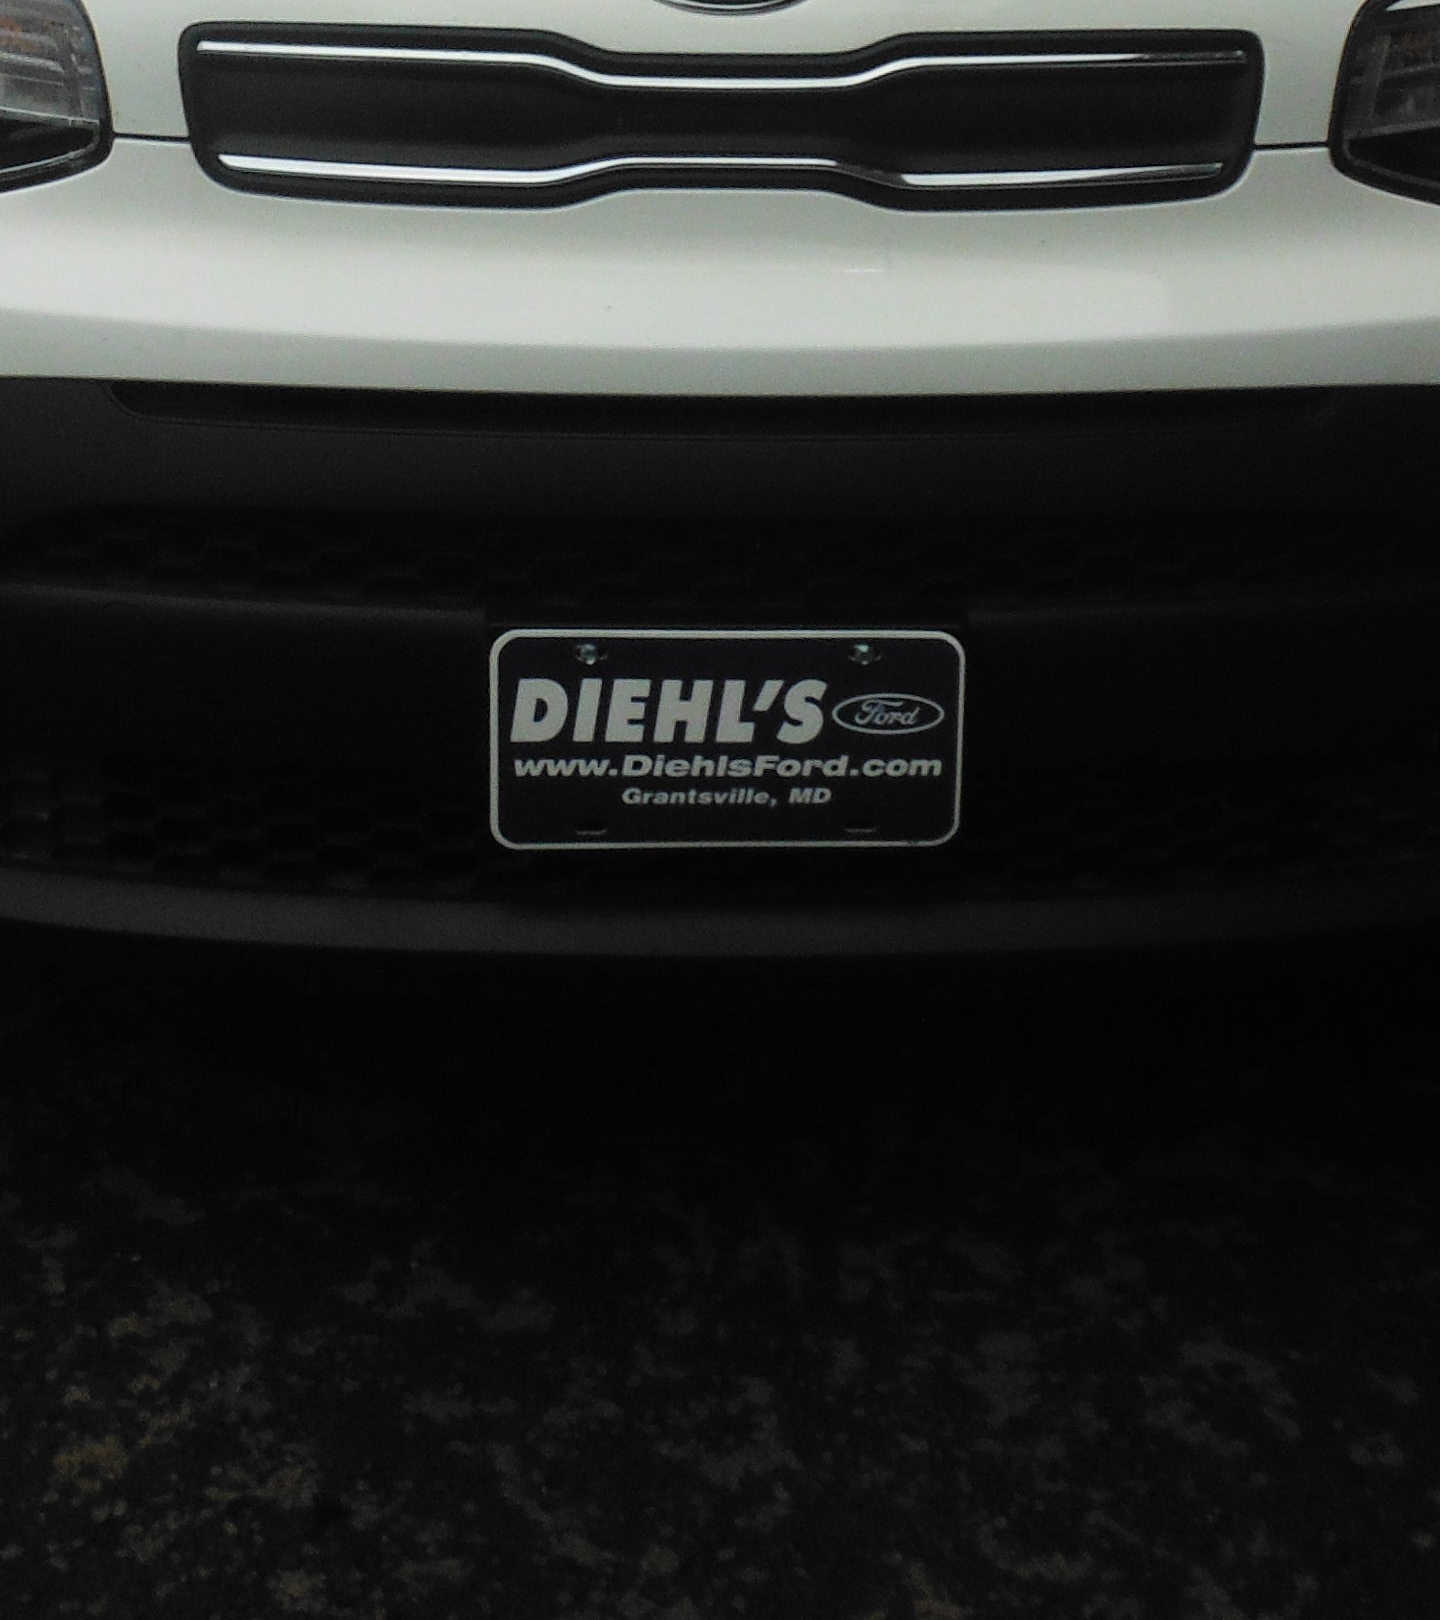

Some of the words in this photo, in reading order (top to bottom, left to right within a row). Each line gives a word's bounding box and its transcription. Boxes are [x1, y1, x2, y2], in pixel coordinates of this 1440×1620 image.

[510, 678, 828, 744] DIEHL'S
[854, 700, 920, 728] Ford
[514, 754, 944, 777] www.DiehlsFord.com
[622, 787, 778, 807] Grantsville,
[789, 788, 832, 805] MD
